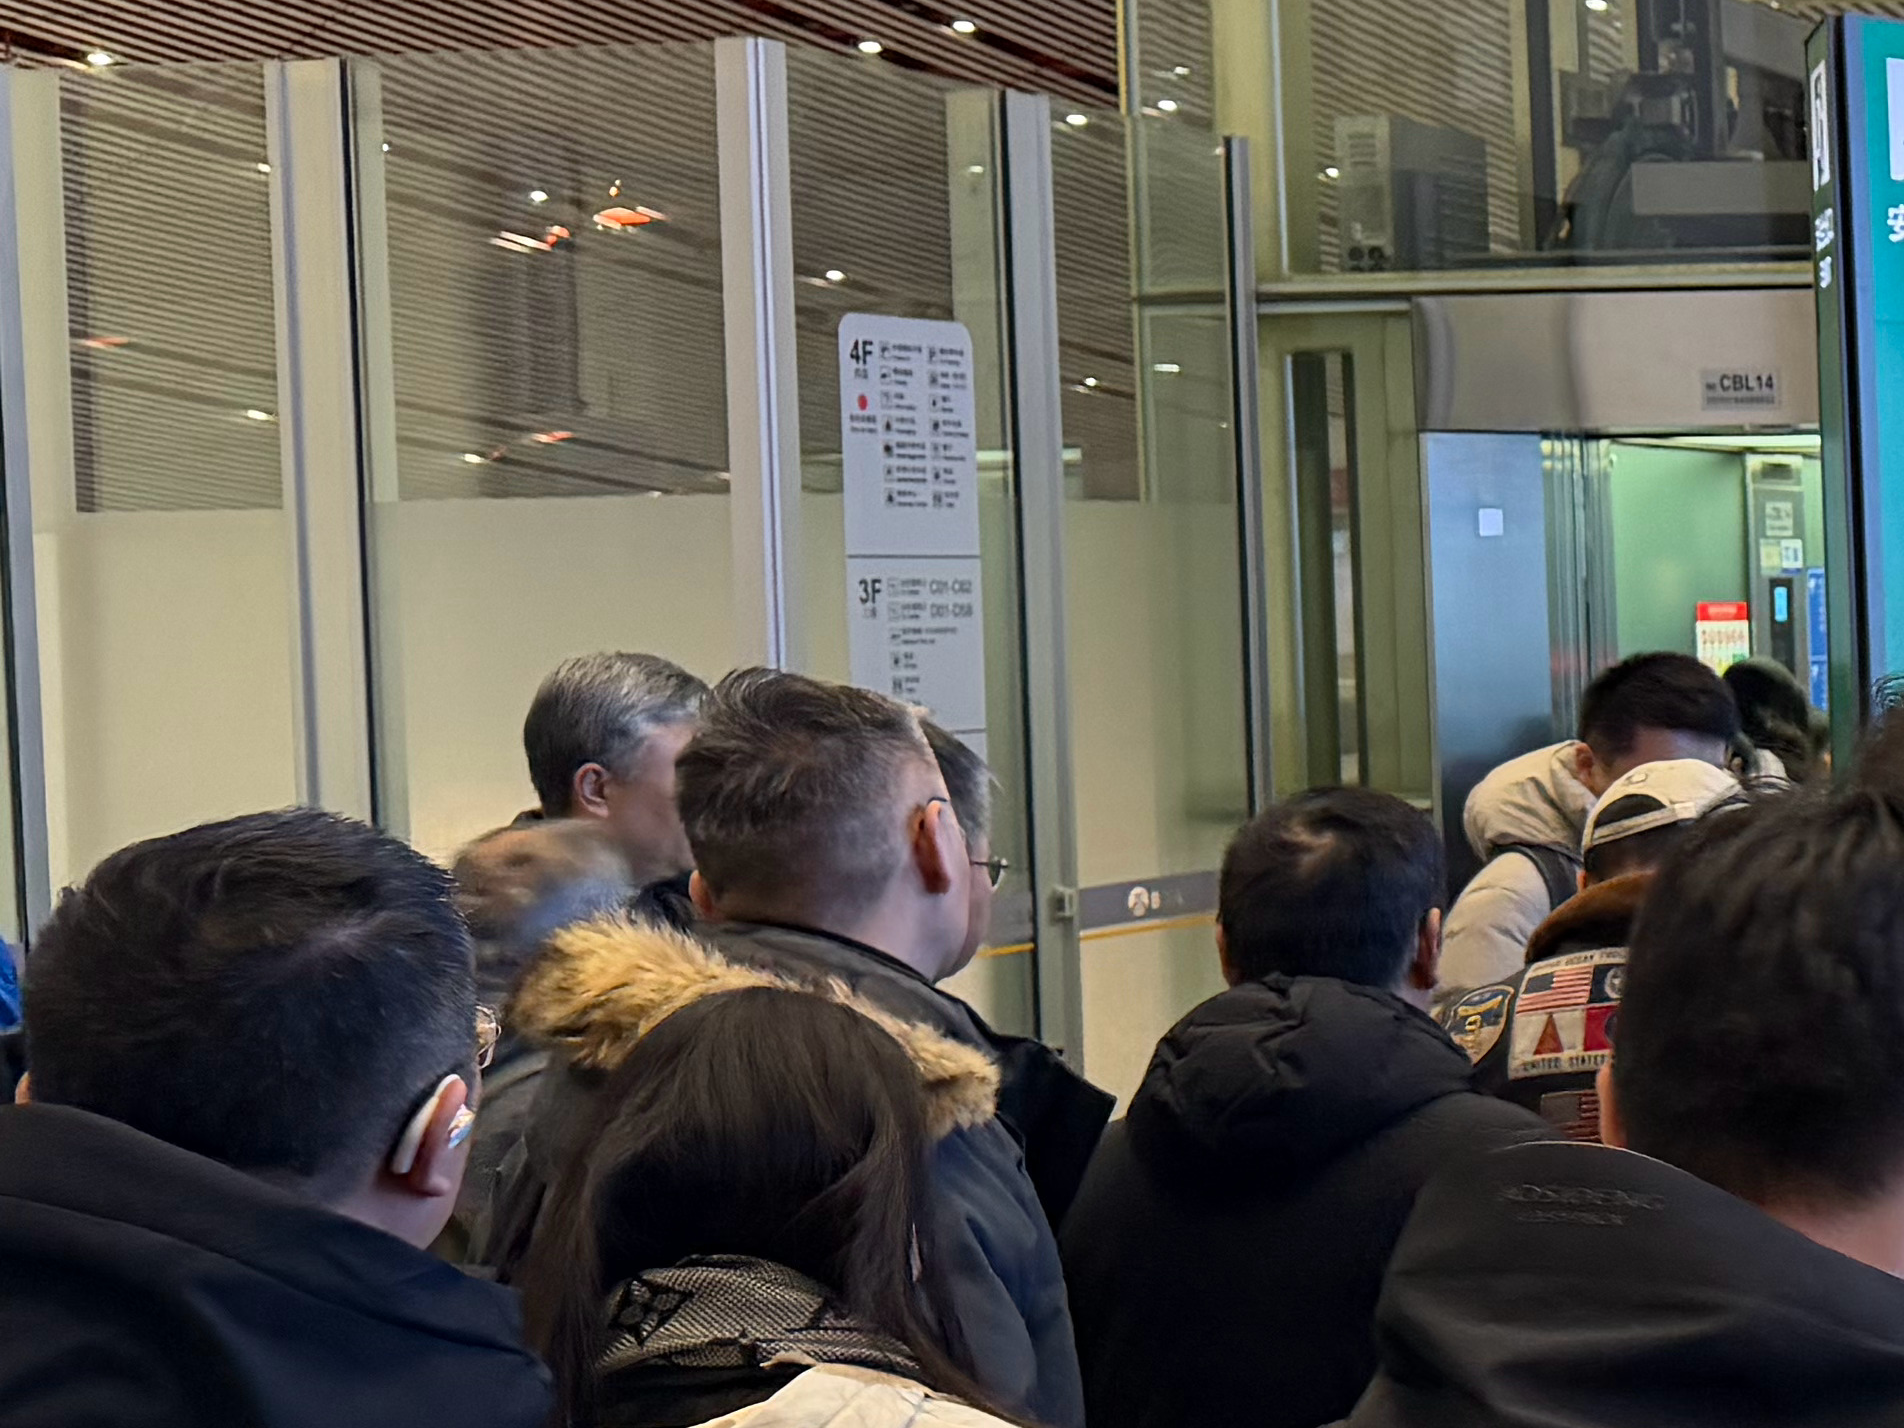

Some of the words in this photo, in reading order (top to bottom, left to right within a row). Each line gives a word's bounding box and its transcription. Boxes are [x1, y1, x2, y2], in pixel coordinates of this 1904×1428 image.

[850, 339, 873, 365] 4F
[1720, 373, 1774, 392] CBL14
[858, 578, 881, 604] 3F
